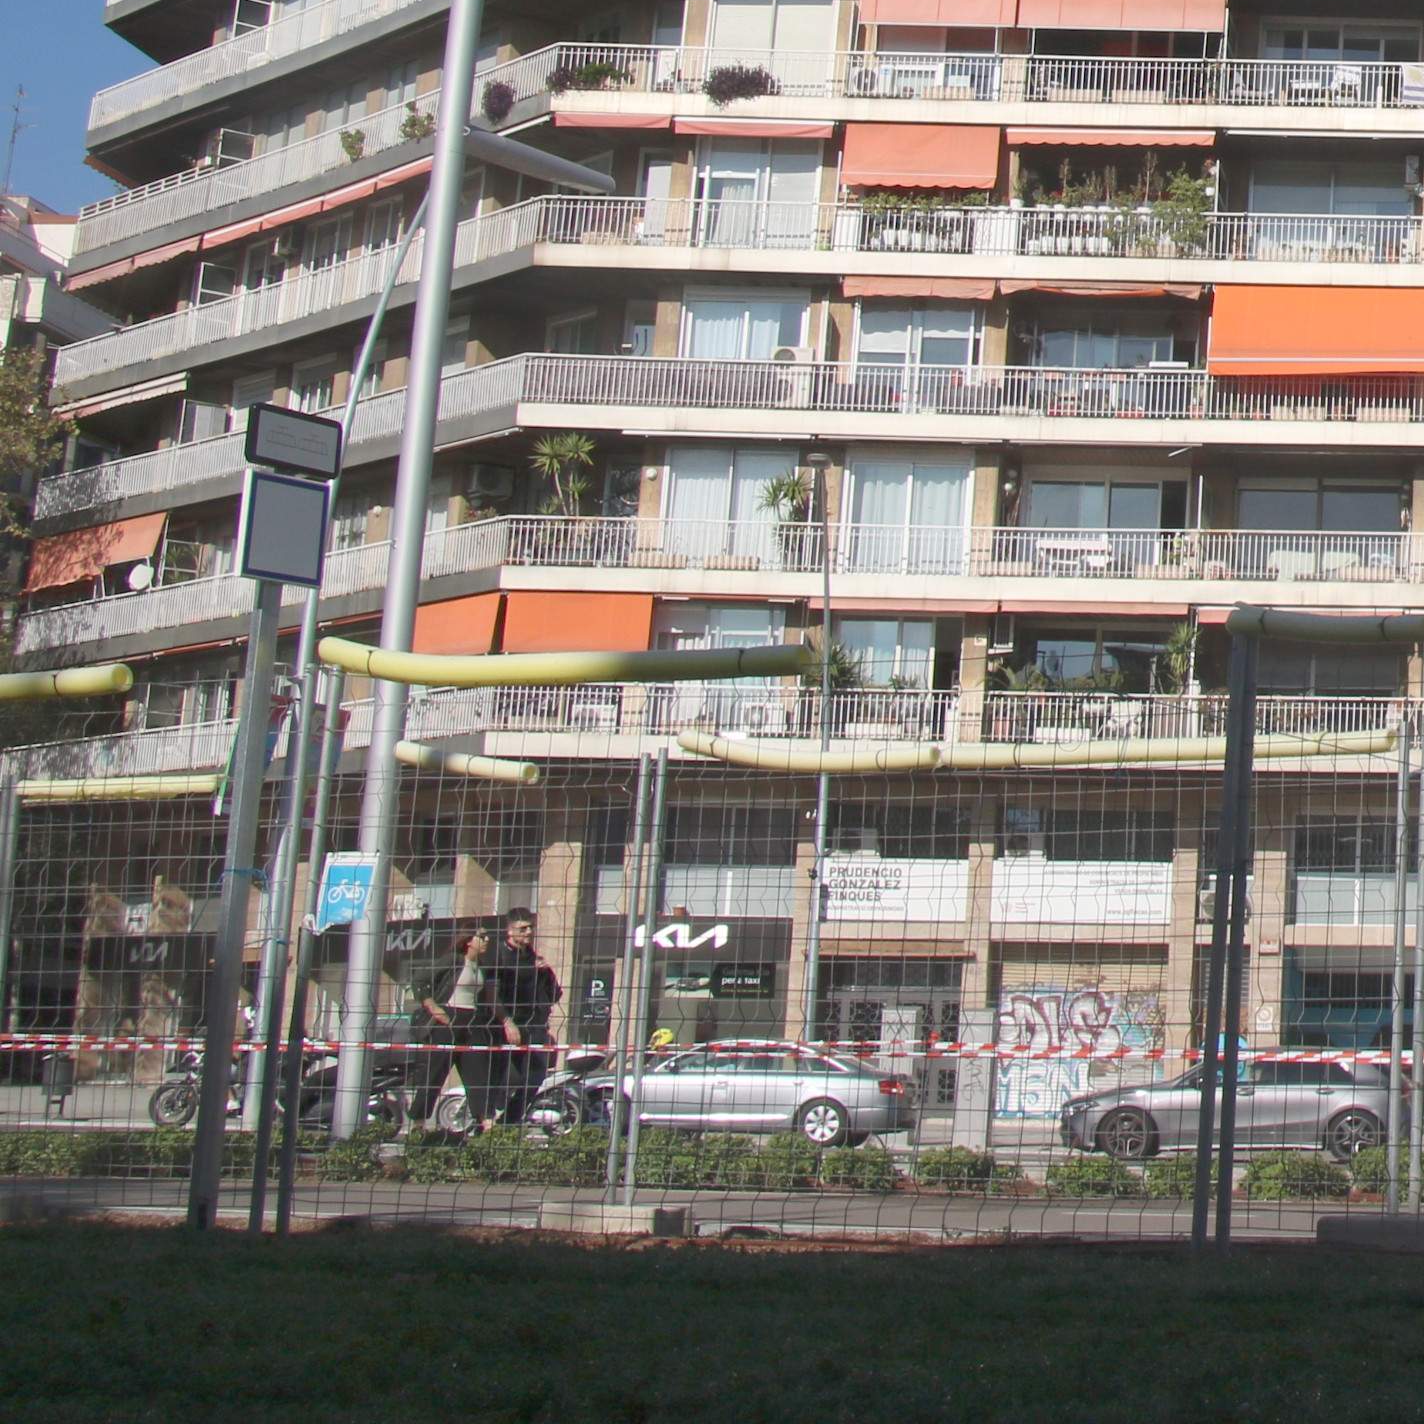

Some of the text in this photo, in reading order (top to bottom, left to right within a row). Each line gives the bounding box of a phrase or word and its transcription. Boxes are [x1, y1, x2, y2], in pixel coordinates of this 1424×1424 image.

[829, 866, 902, 878] PRUDENCIO
[828, 890, 882, 902] FINQUES
[744, 976, 760, 985] taxi
